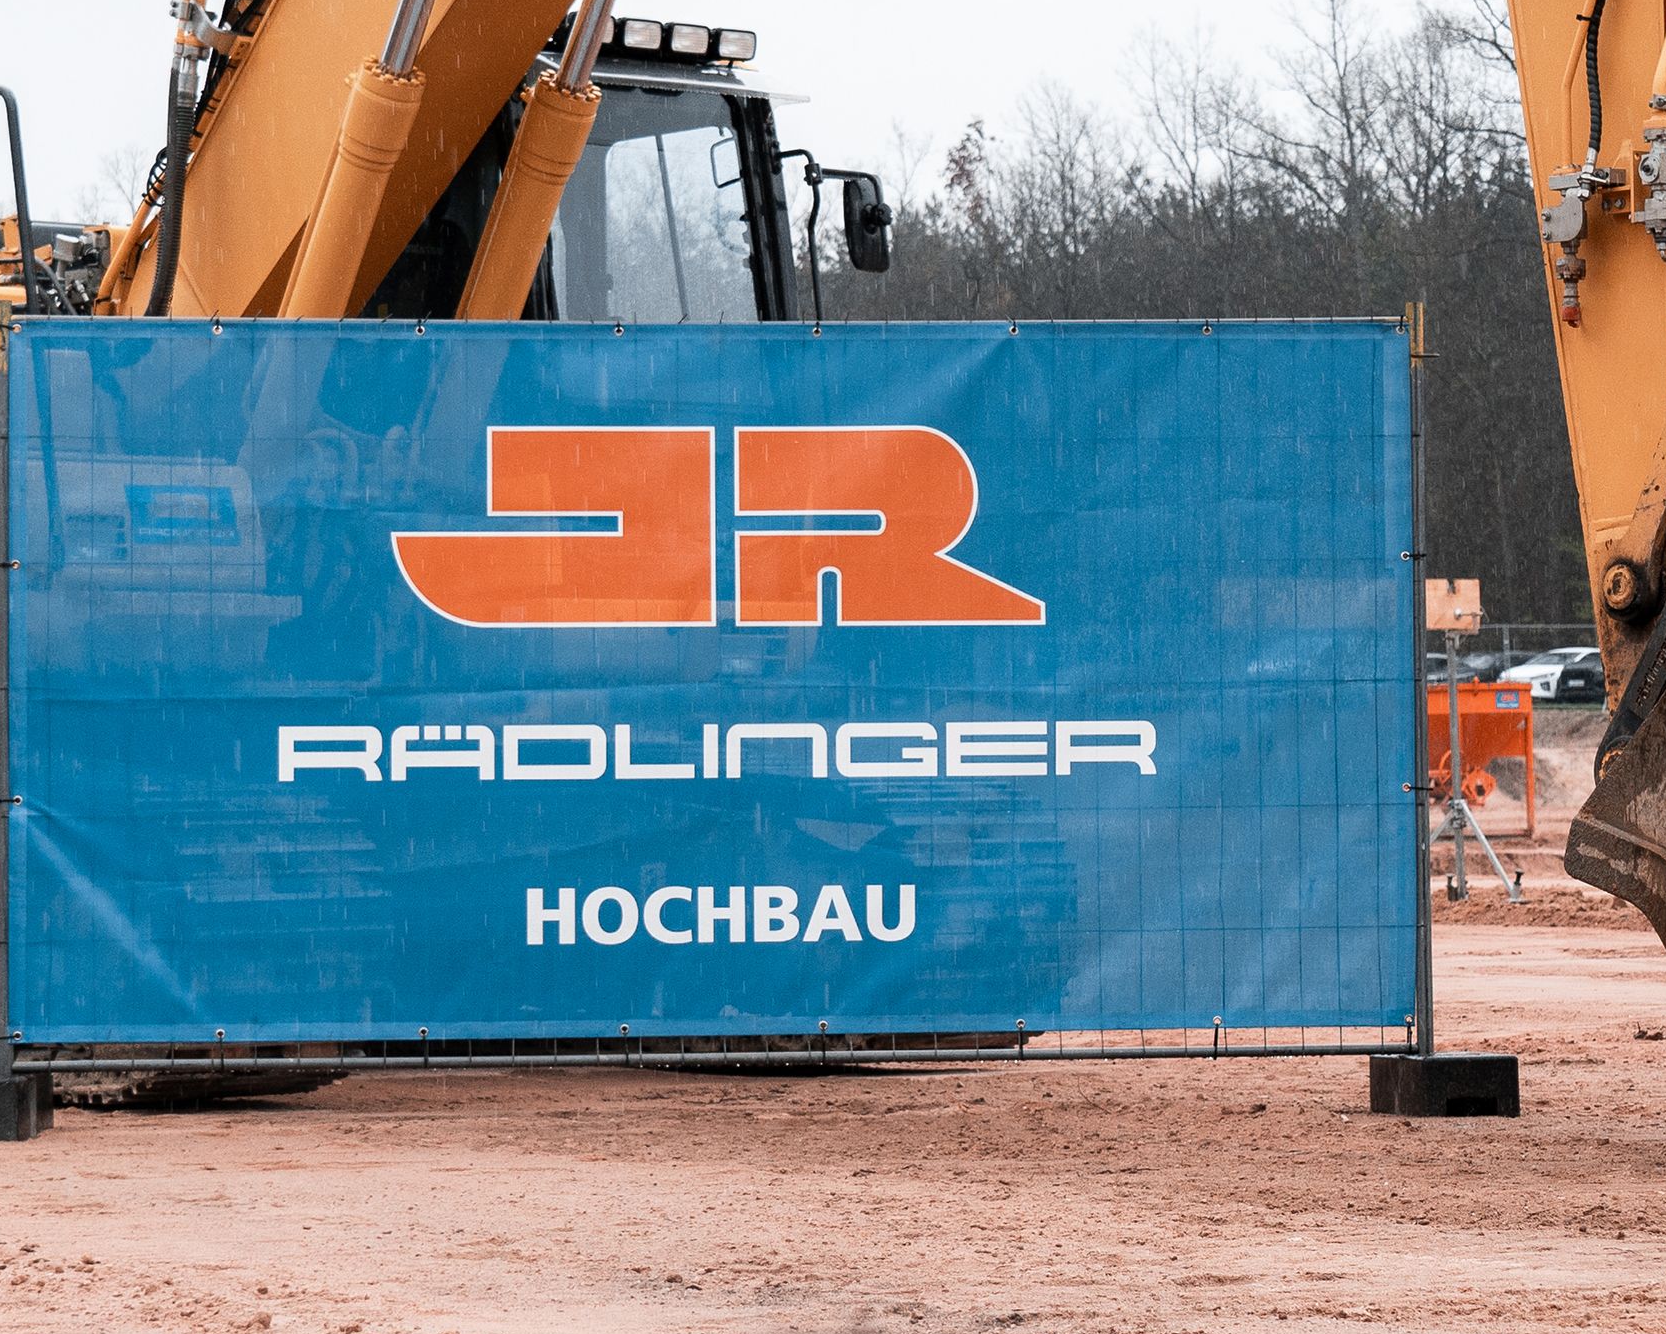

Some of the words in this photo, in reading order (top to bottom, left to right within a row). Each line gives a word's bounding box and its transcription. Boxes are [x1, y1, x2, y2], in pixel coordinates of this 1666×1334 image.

[390, 424, 1046, 629] JR
[277, 720, 1158, 782] RÄDLINGER
[526, 884, 917, 945] HOCHBAU
